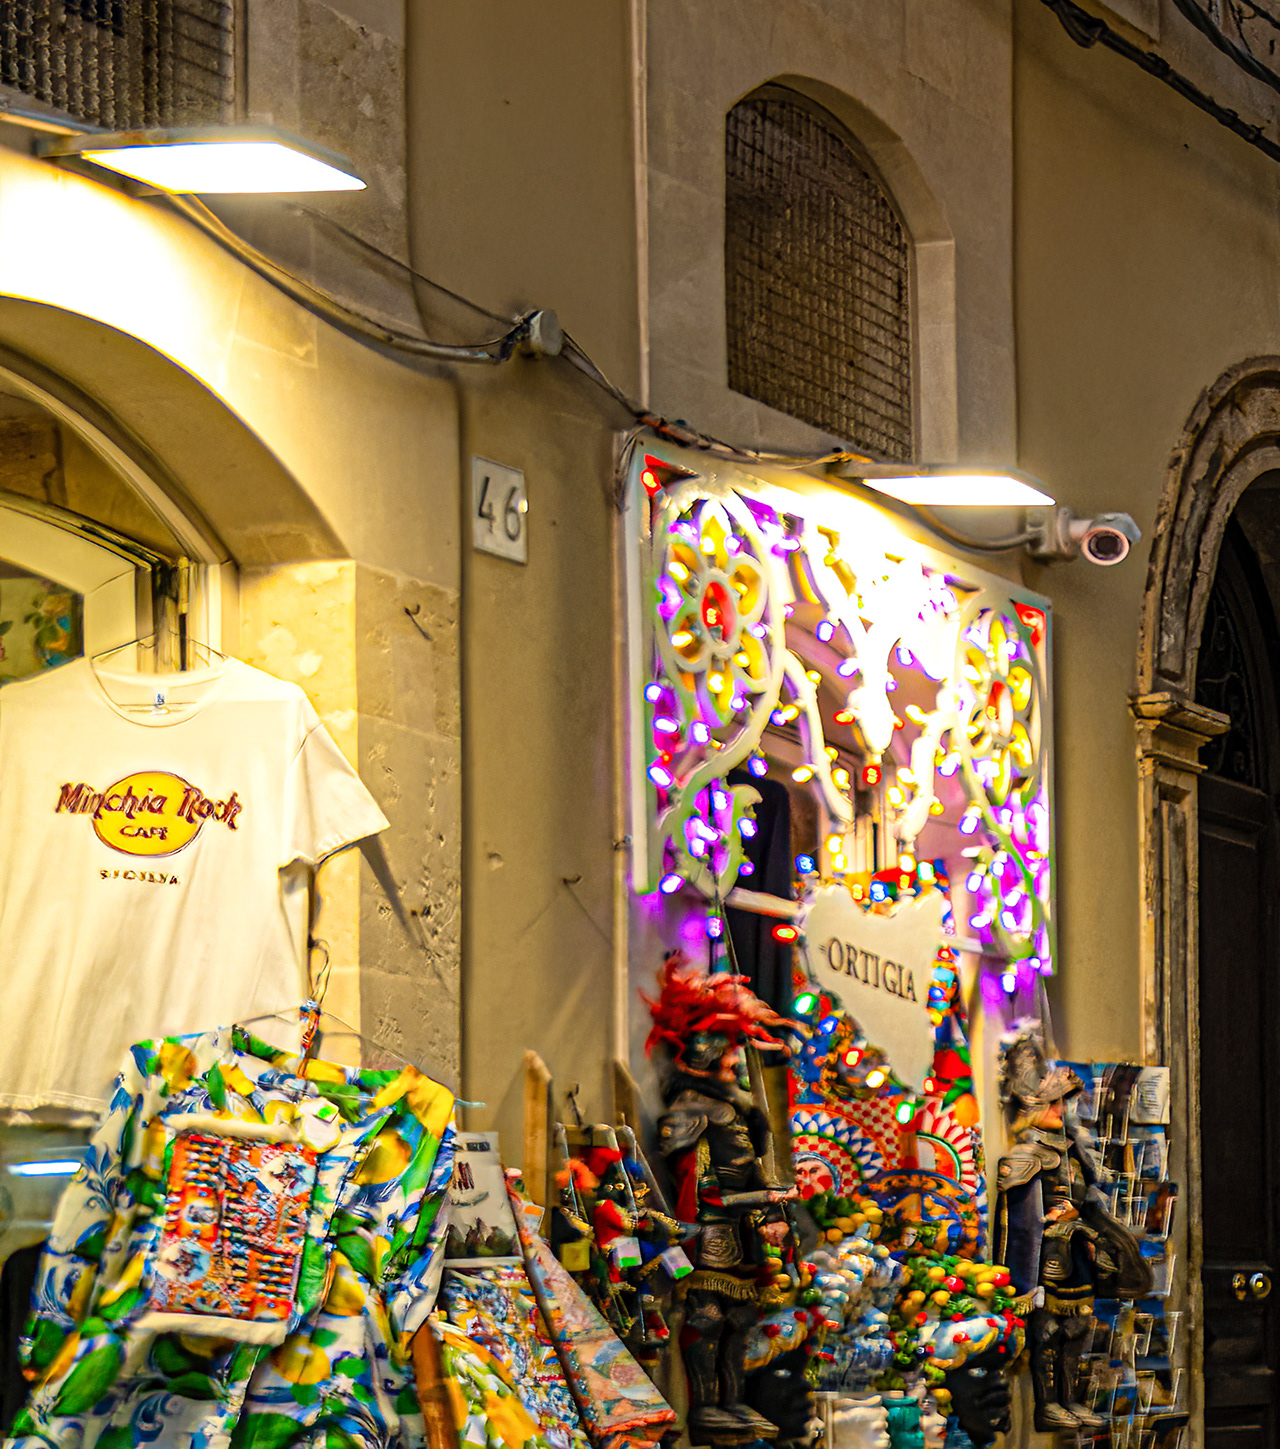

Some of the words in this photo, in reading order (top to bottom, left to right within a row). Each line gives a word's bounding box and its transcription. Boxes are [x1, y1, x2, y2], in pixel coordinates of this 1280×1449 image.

[479, 476, 521, 542] 46
[55, 782, 168, 820] Minchia
[177, 787, 243, 831] Rock
[828, 937, 917, 1002] ORTIGIA
